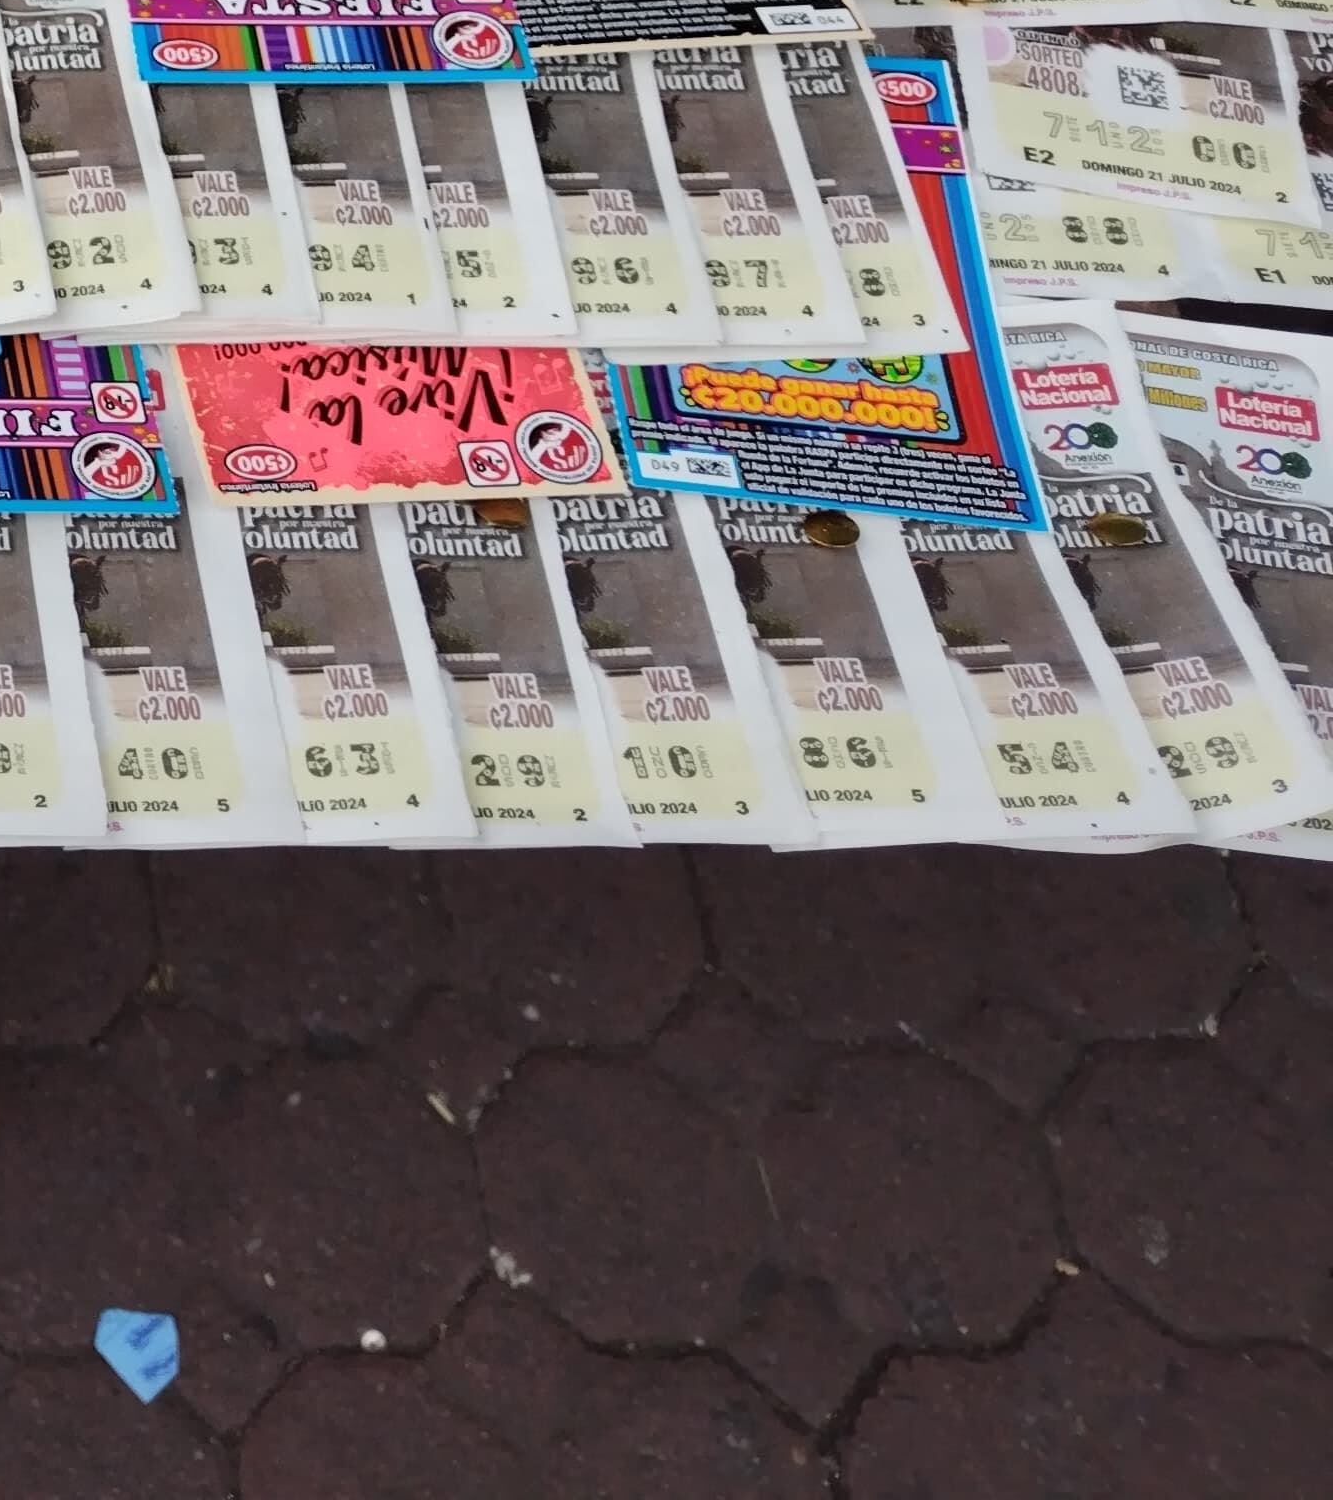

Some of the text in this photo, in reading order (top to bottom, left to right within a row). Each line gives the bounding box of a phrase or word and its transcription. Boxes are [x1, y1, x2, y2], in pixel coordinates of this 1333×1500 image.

[1021, 44, 1083, 70] SORTEO
[1024, 147, 1056, 165] E2
[1081, 159, 1145, 178] DOMINGO
[1171, 171, 1205, 189] JULIO
[1208, 180, 1242, 195] 2024
[1169, 347, 1279, 371] DE COSTA RICA
[1220, 408, 1312, 436] Nacional
[1008, 665, 1056, 687] VALE
